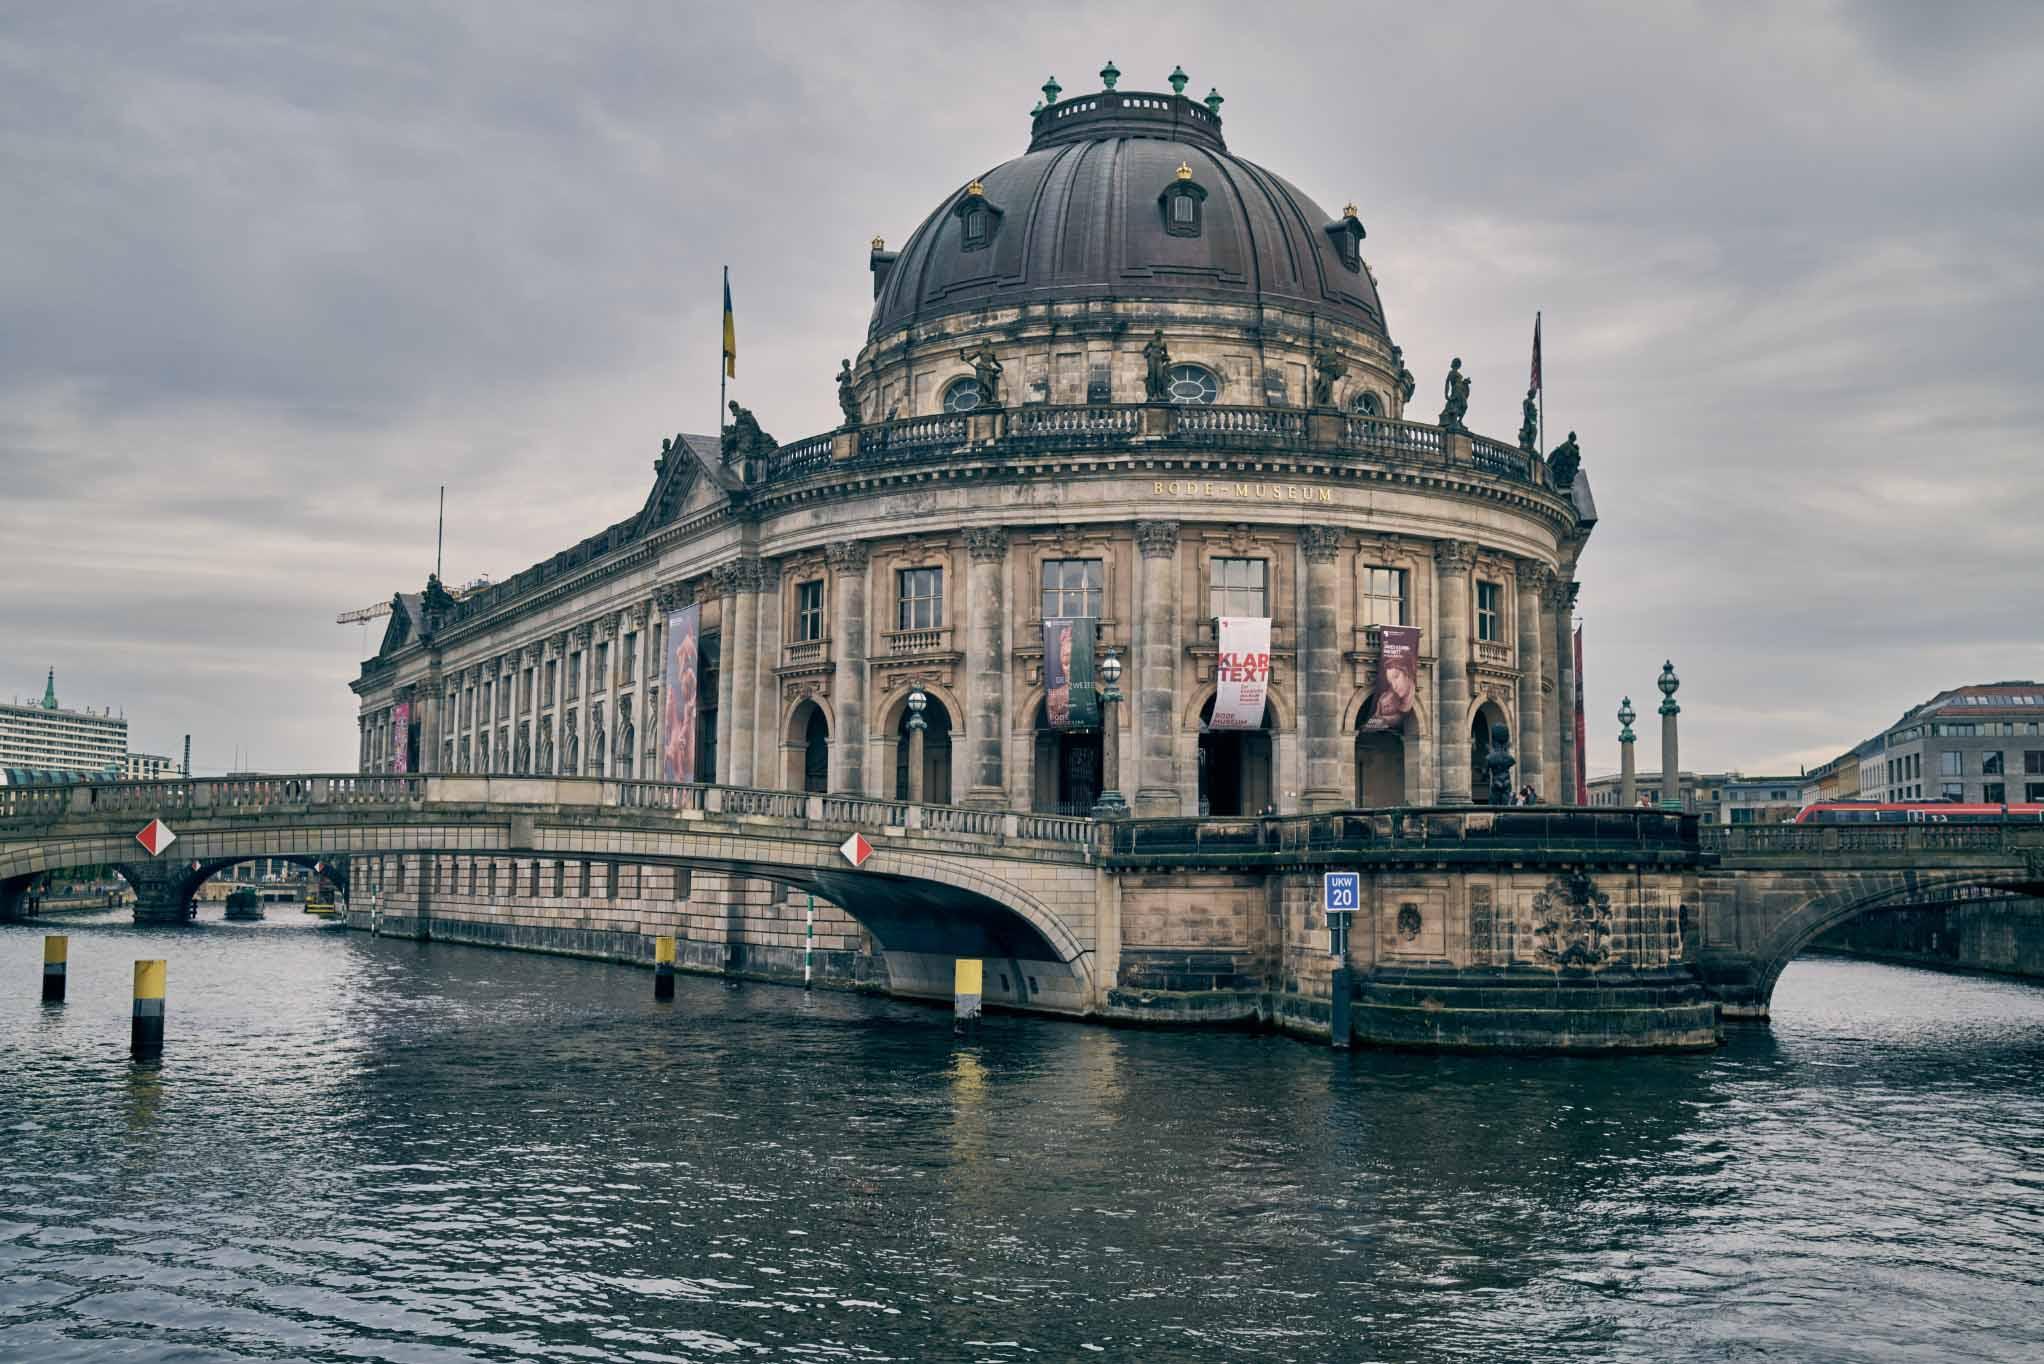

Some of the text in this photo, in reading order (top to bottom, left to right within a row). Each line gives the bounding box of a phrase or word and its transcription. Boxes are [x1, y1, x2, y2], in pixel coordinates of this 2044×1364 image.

[1152, 481, 1331, 501] BODE-MUSEUM
[1218, 652, 1269, 667] KLAR
[1217, 667, 1268, 682] TEXT
[1332, 877, 1353, 887] UKW
[1333, 889, 1352, 906] 20
